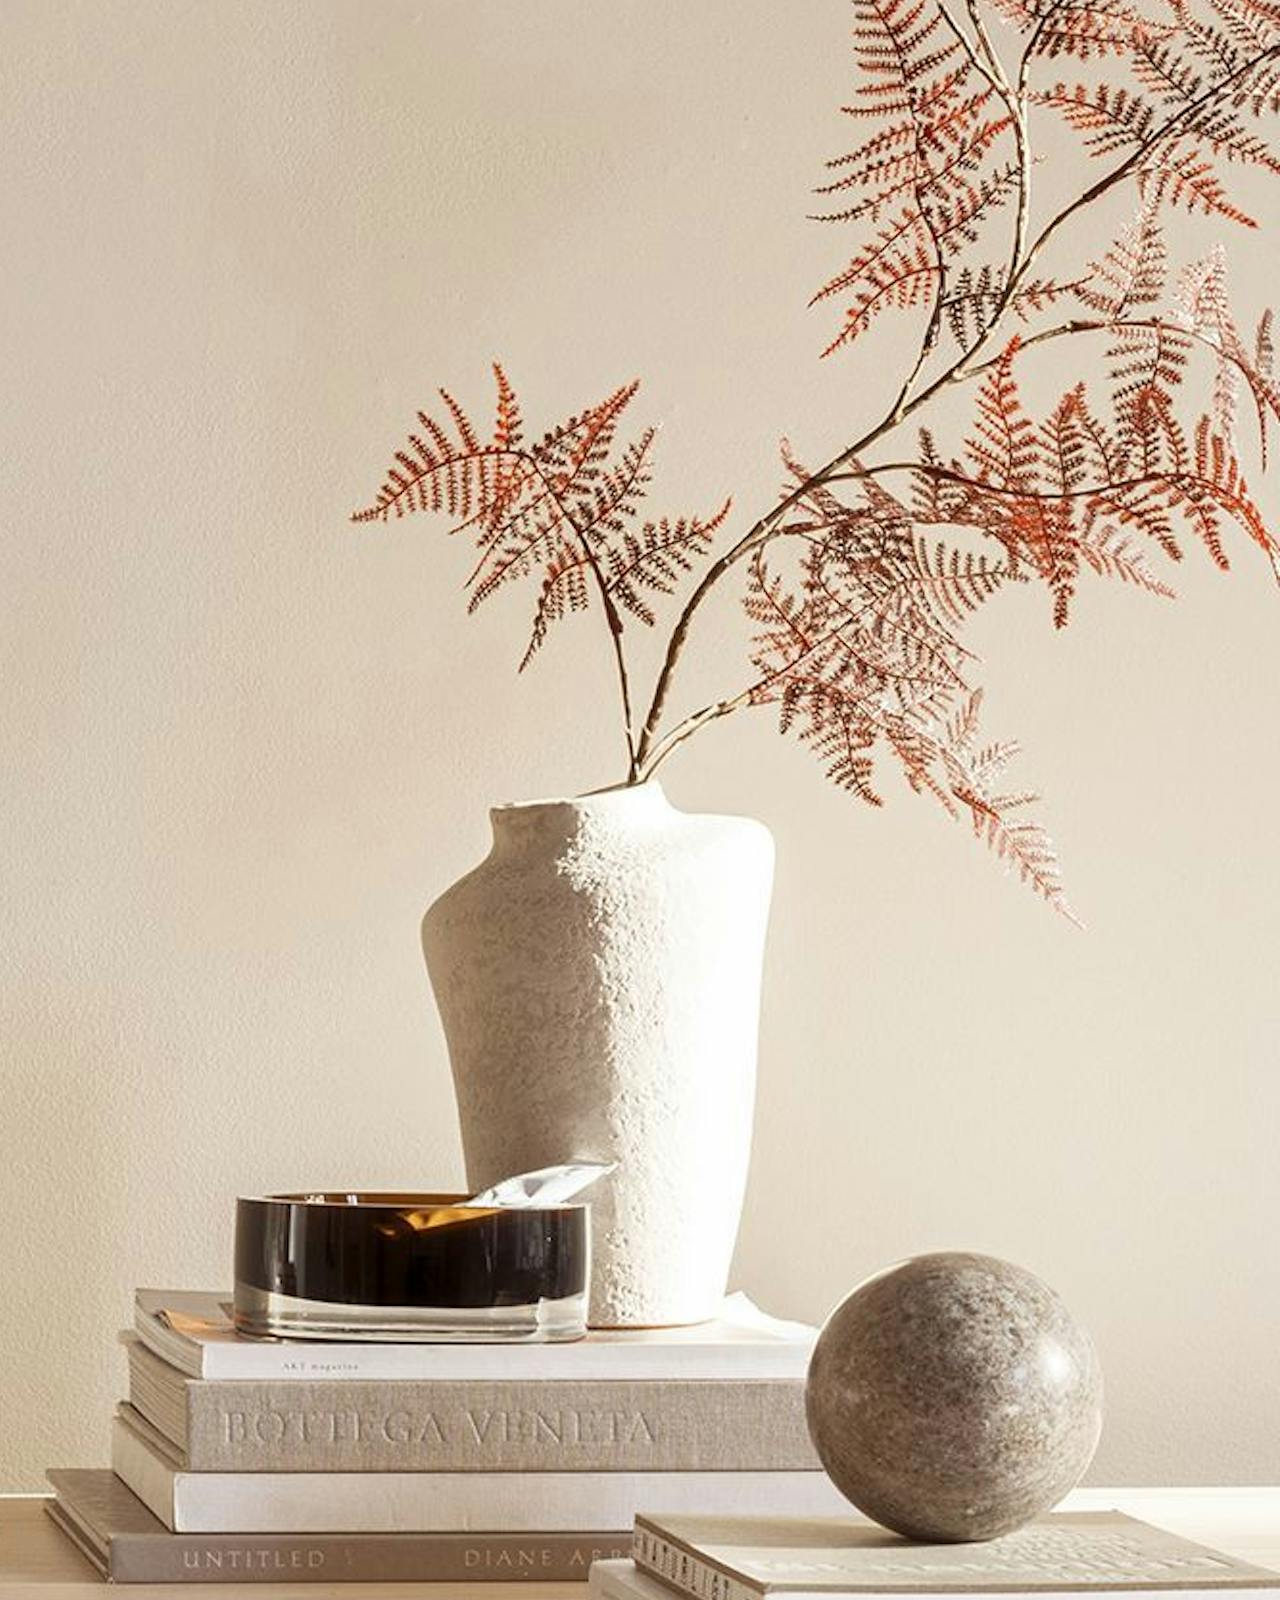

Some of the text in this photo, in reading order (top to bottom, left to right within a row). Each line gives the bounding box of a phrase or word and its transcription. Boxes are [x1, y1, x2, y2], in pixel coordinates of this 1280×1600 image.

[222, 1410, 657, 1446] BOTTEGA VENETA
[183, 1549, 326, 1568] UNTITLED
[464, 1549, 553, 1568] DIANE
